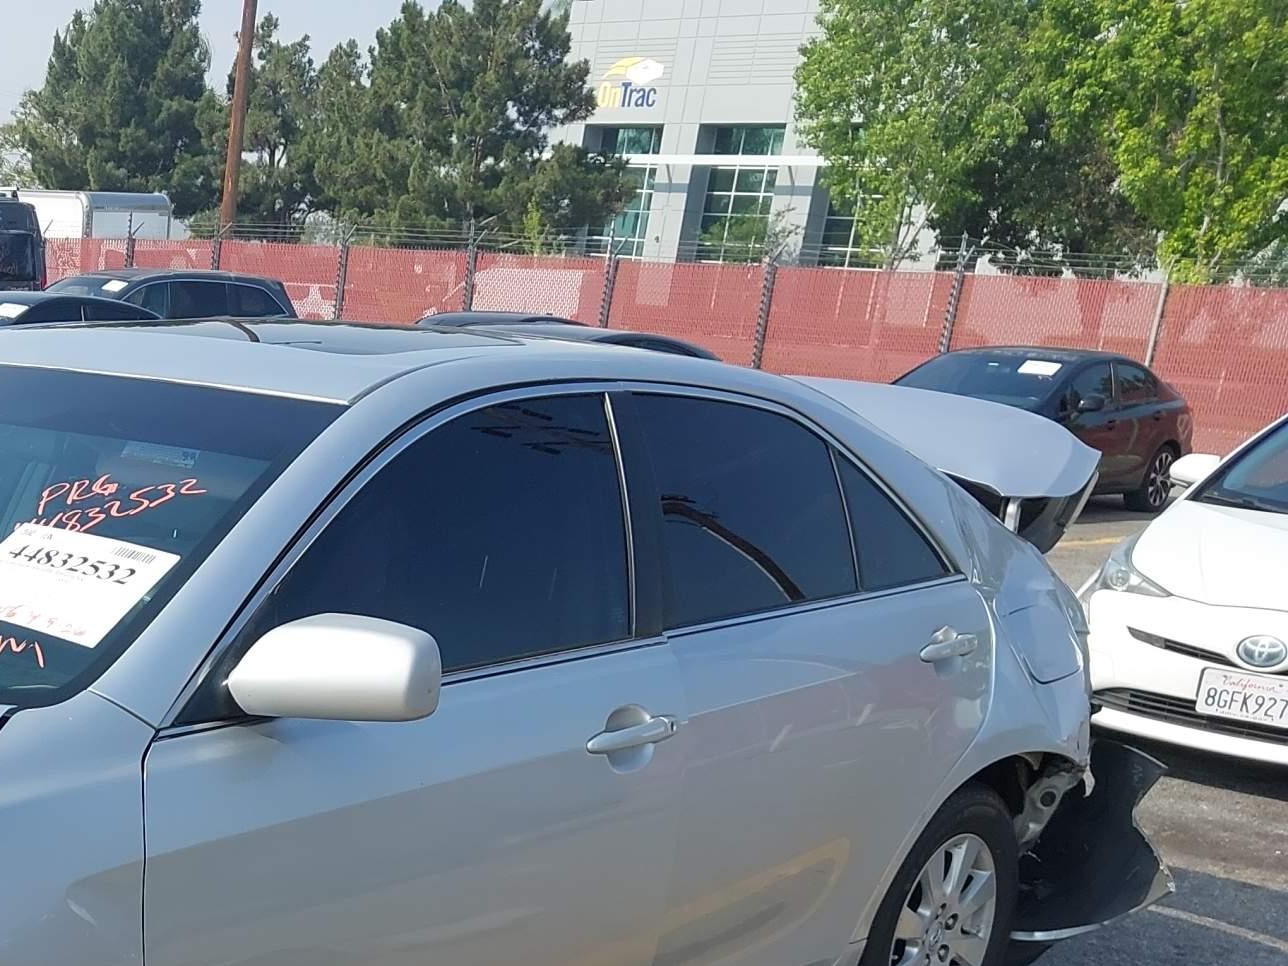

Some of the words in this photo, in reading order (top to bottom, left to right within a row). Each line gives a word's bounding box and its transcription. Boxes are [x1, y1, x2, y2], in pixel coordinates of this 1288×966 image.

[597, 81, 657, 108] OnTrac
[8, 544, 137, 584] 44832532
[1204, 687, 1288, 719] 8GFK927
